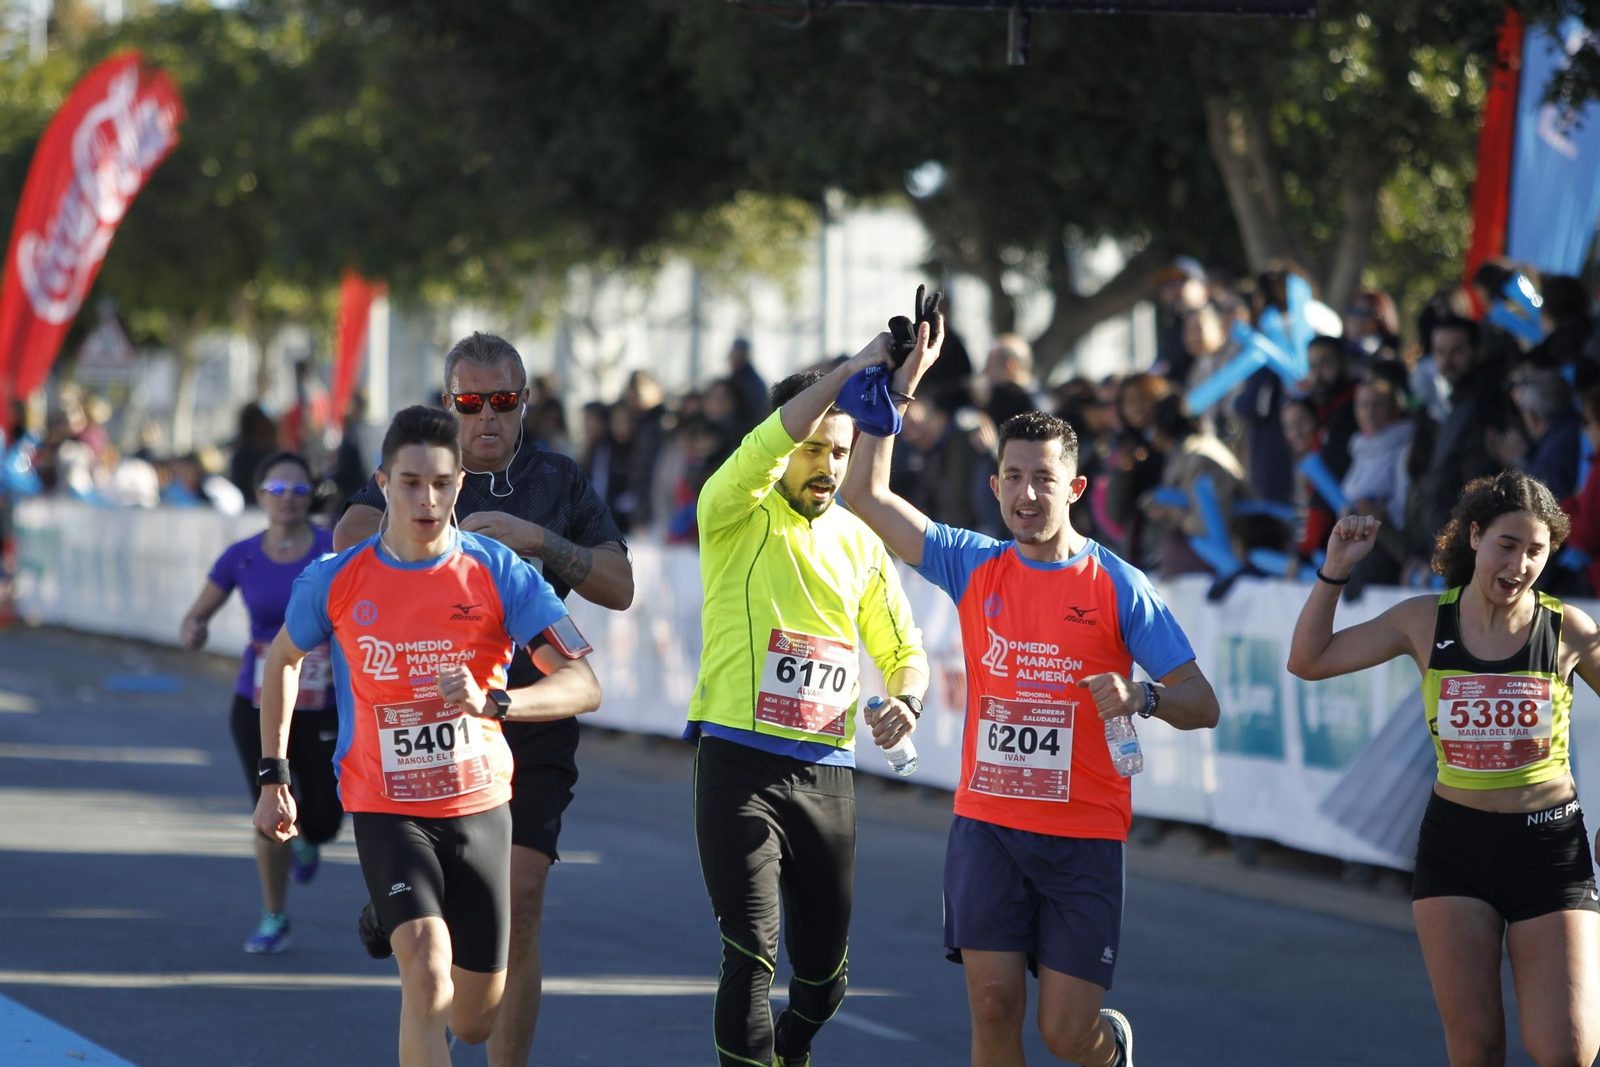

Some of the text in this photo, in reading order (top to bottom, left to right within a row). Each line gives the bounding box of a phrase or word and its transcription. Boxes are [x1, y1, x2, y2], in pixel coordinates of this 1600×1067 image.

[404, 640, 453, 653] MEDIO
[1017, 641, 1059, 655] MEDIO
[406, 649, 476, 665] MARATÓN
[1016, 655, 1083, 670] MARATÓN
[776, 656, 847, 693] 6170
[1016, 669, 1074, 684] ALMERÍA
[1498, 688, 1543, 696] SALUDABLE
[436, 708, 462, 718] SALUD
[1031, 708, 1065, 716] CARRERA
[1449, 699, 1539, 729] 5388
[1022, 715, 1065, 724] SALUDABLE
[393, 717, 470, 757] 5401
[1458, 727, 1529, 737] MARÍA DEL MAR
[988, 722, 1060, 757] 6204
[397, 755, 434, 766] MANOLO
[436, 753, 448, 761] EL
[1004, 753, 1026, 762] IVÁN
[1526, 806, 1563, 827] NIKE
